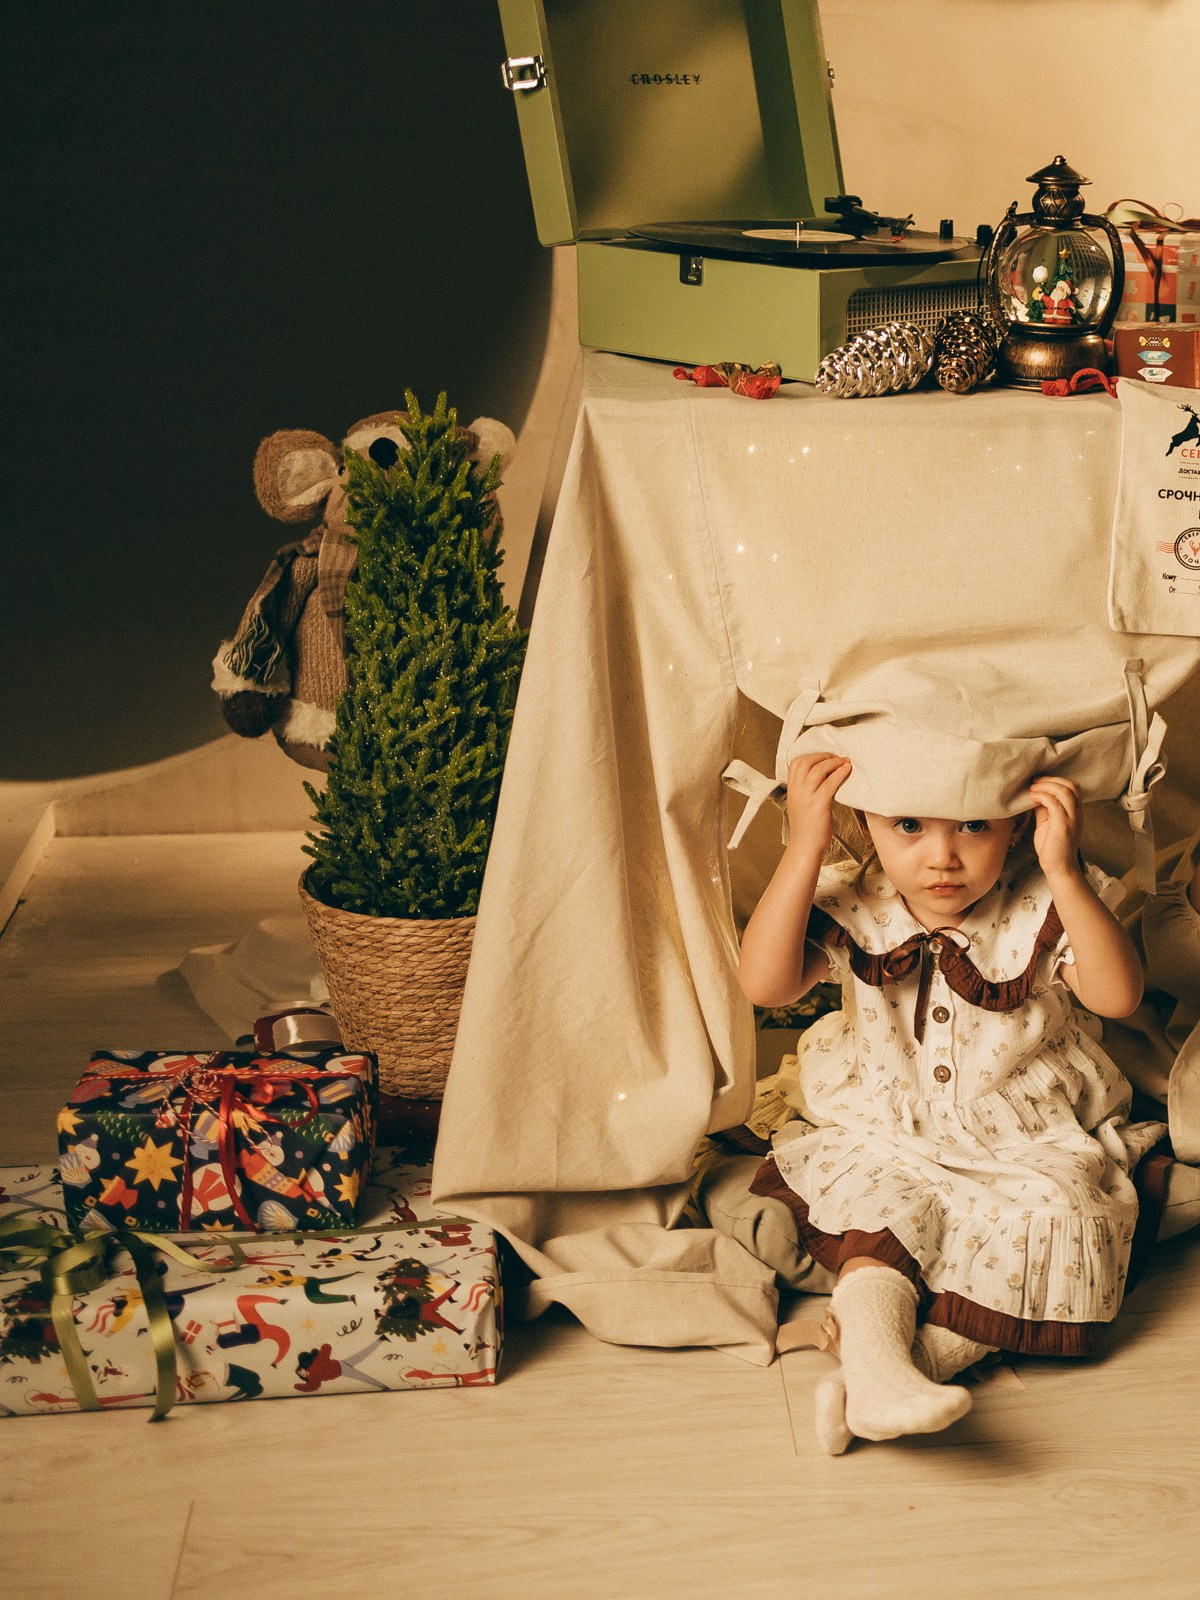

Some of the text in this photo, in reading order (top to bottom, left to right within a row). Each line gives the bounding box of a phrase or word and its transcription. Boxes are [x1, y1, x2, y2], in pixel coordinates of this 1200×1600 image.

[630, 73, 702, 85] CROSLEY
[1162, 572, 1177, 582] Кому
[1168, 585, 1176, 594] От
